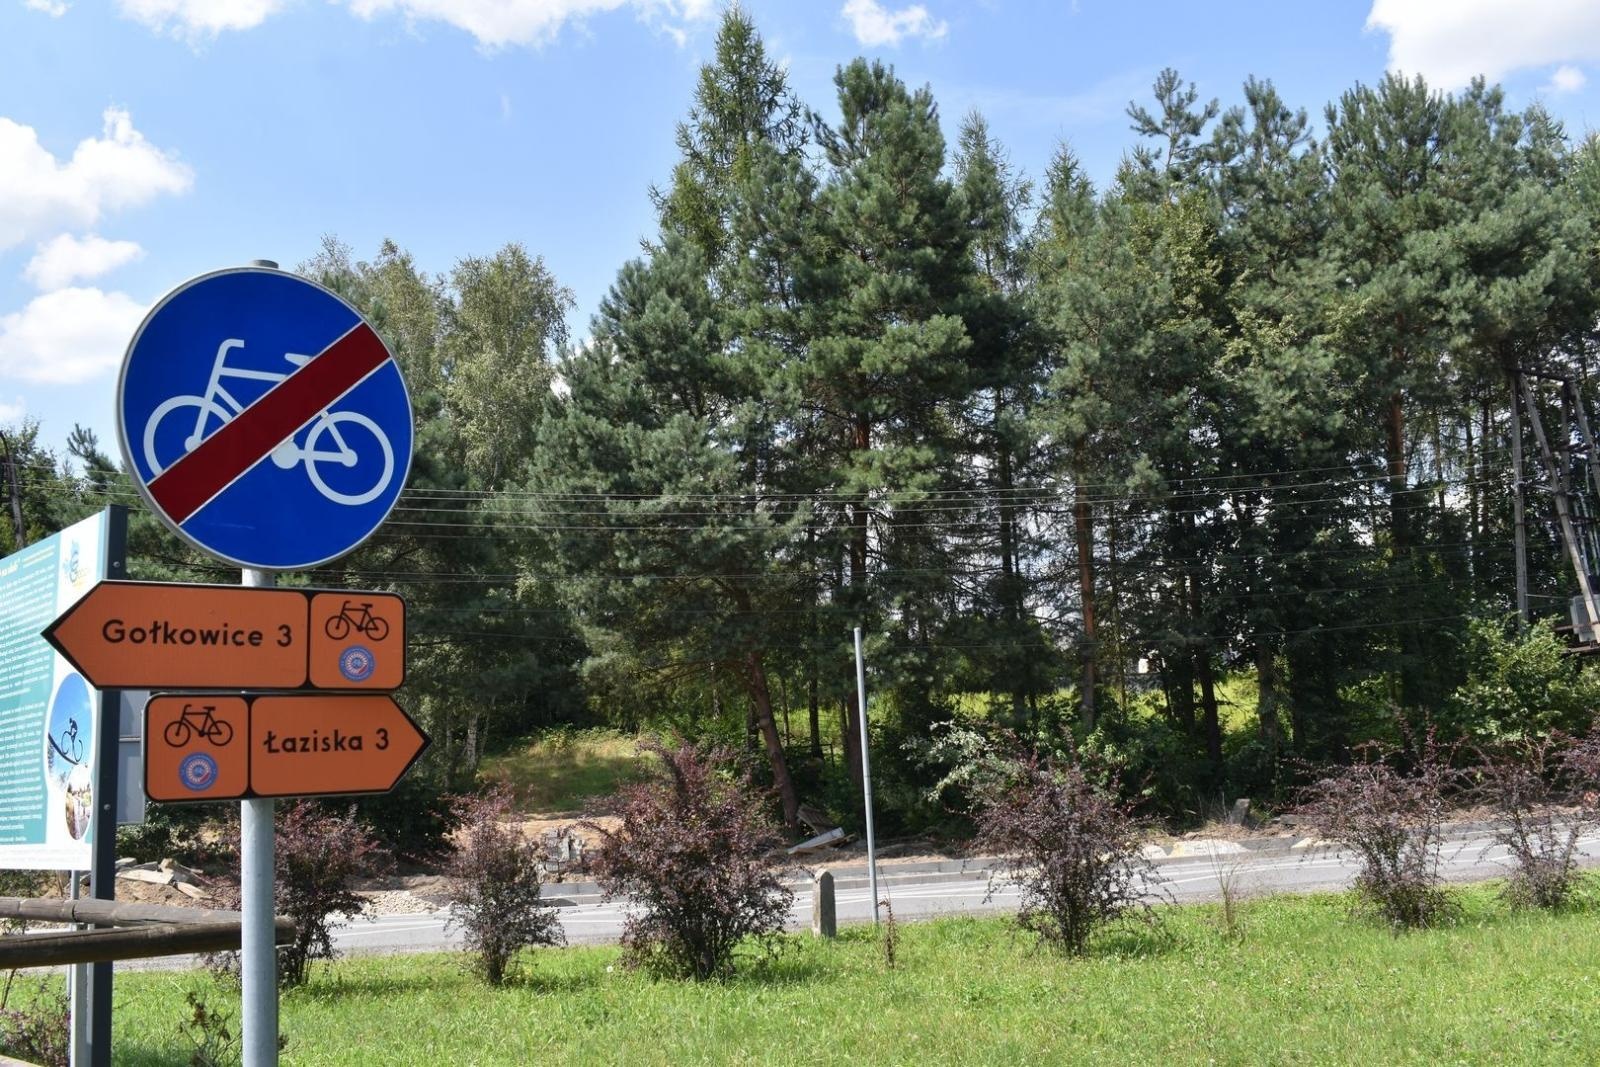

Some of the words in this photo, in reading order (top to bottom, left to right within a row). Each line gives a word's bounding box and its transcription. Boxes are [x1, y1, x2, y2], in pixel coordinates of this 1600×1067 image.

[102, 619, 263, 647] Gołkowice
[277, 624, 292, 647] 3
[263, 729, 363, 753] Łaziska
[375, 728, 389, 750] 3
